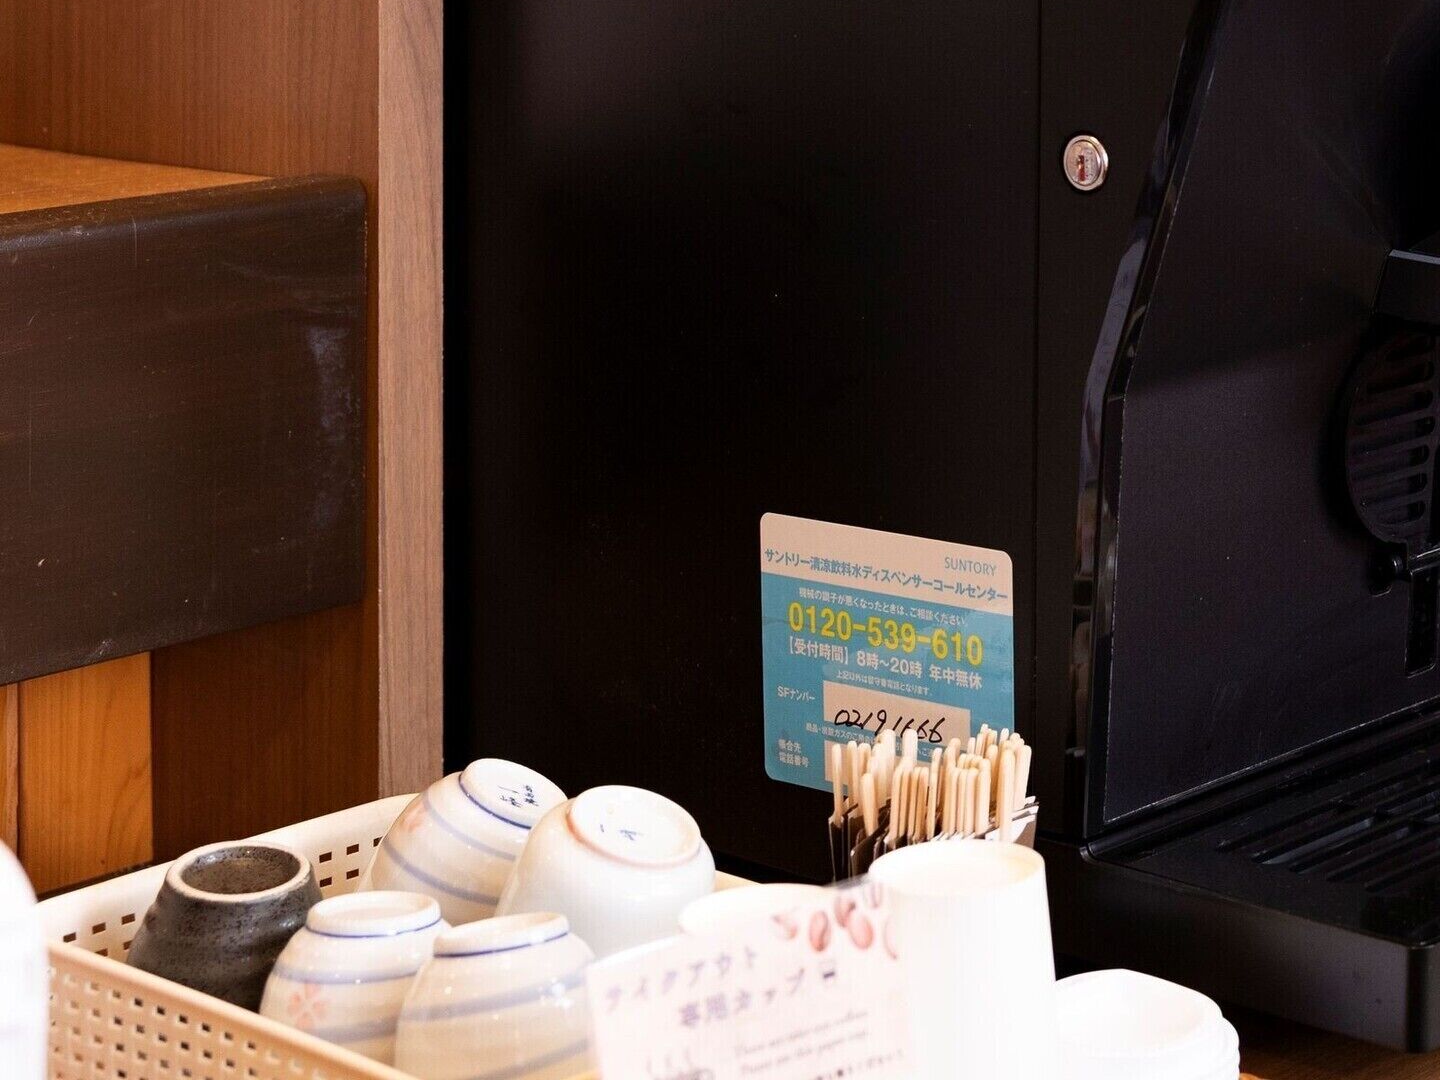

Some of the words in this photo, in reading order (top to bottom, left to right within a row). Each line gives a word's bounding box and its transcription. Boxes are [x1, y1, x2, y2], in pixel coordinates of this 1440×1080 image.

[764, 548, 1009, 602] サントリー清涼飲料水ディスペンサーコールセンター
[944, 556, 998, 577] SUNTORY
[787, 601, 984, 668] 0120-539-610
[929, 664, 984, 690] 年中無休
[777, 685, 816, 702] SFナンバー
